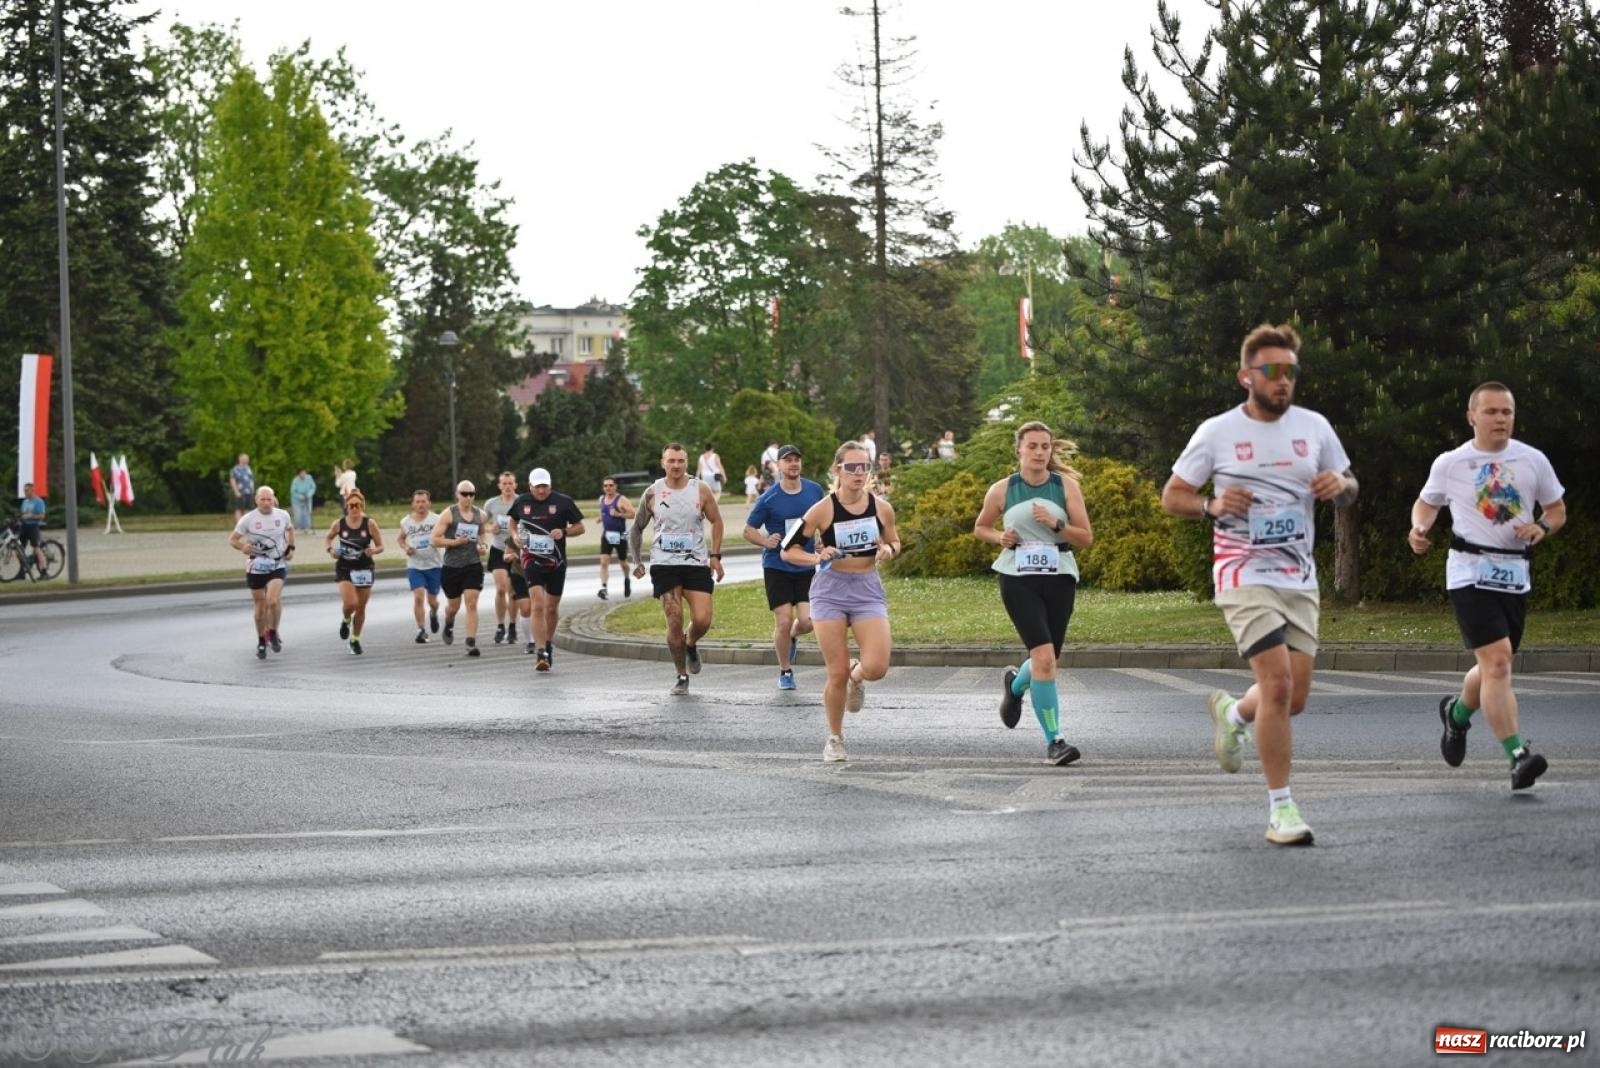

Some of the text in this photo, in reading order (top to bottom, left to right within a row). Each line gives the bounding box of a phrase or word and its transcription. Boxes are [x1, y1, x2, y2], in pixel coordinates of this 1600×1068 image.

[1264, 518, 1295, 535] 250
[848, 531, 869, 544] 176
[669, 540, 685, 549] 196
[1025, 554, 1049, 566] 188
[1491, 567, 1514, 582] 221
